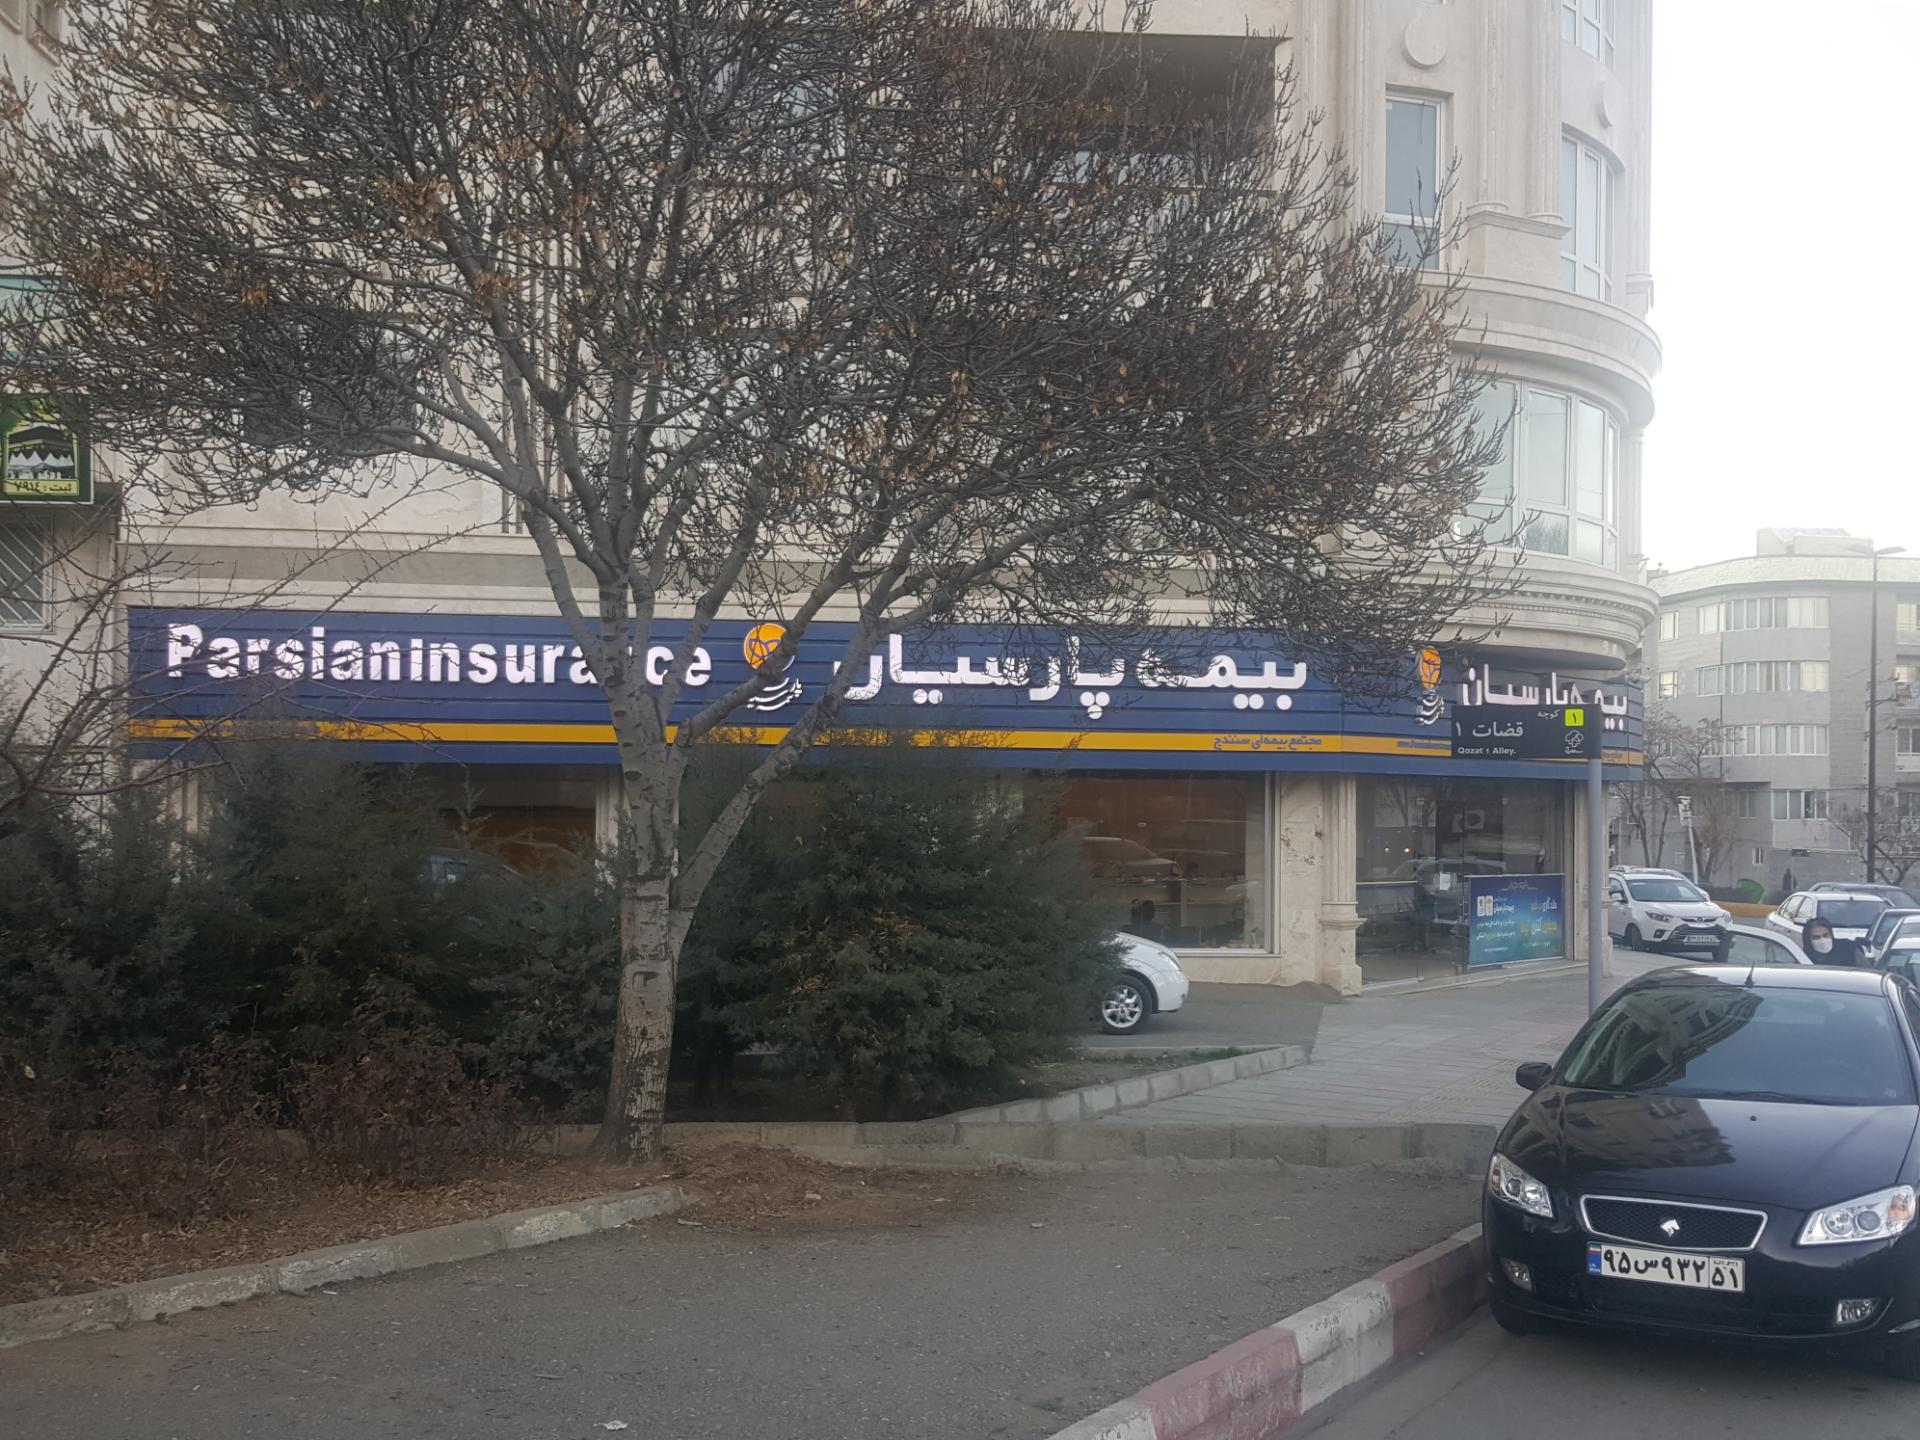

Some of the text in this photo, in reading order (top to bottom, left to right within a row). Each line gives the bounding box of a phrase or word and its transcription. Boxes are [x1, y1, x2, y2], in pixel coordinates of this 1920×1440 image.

[1136, 648, 1307, 711] بیمه
[1472, 720, 1524, 737] قضات
[1458, 746, 1483, 755] Qozat
